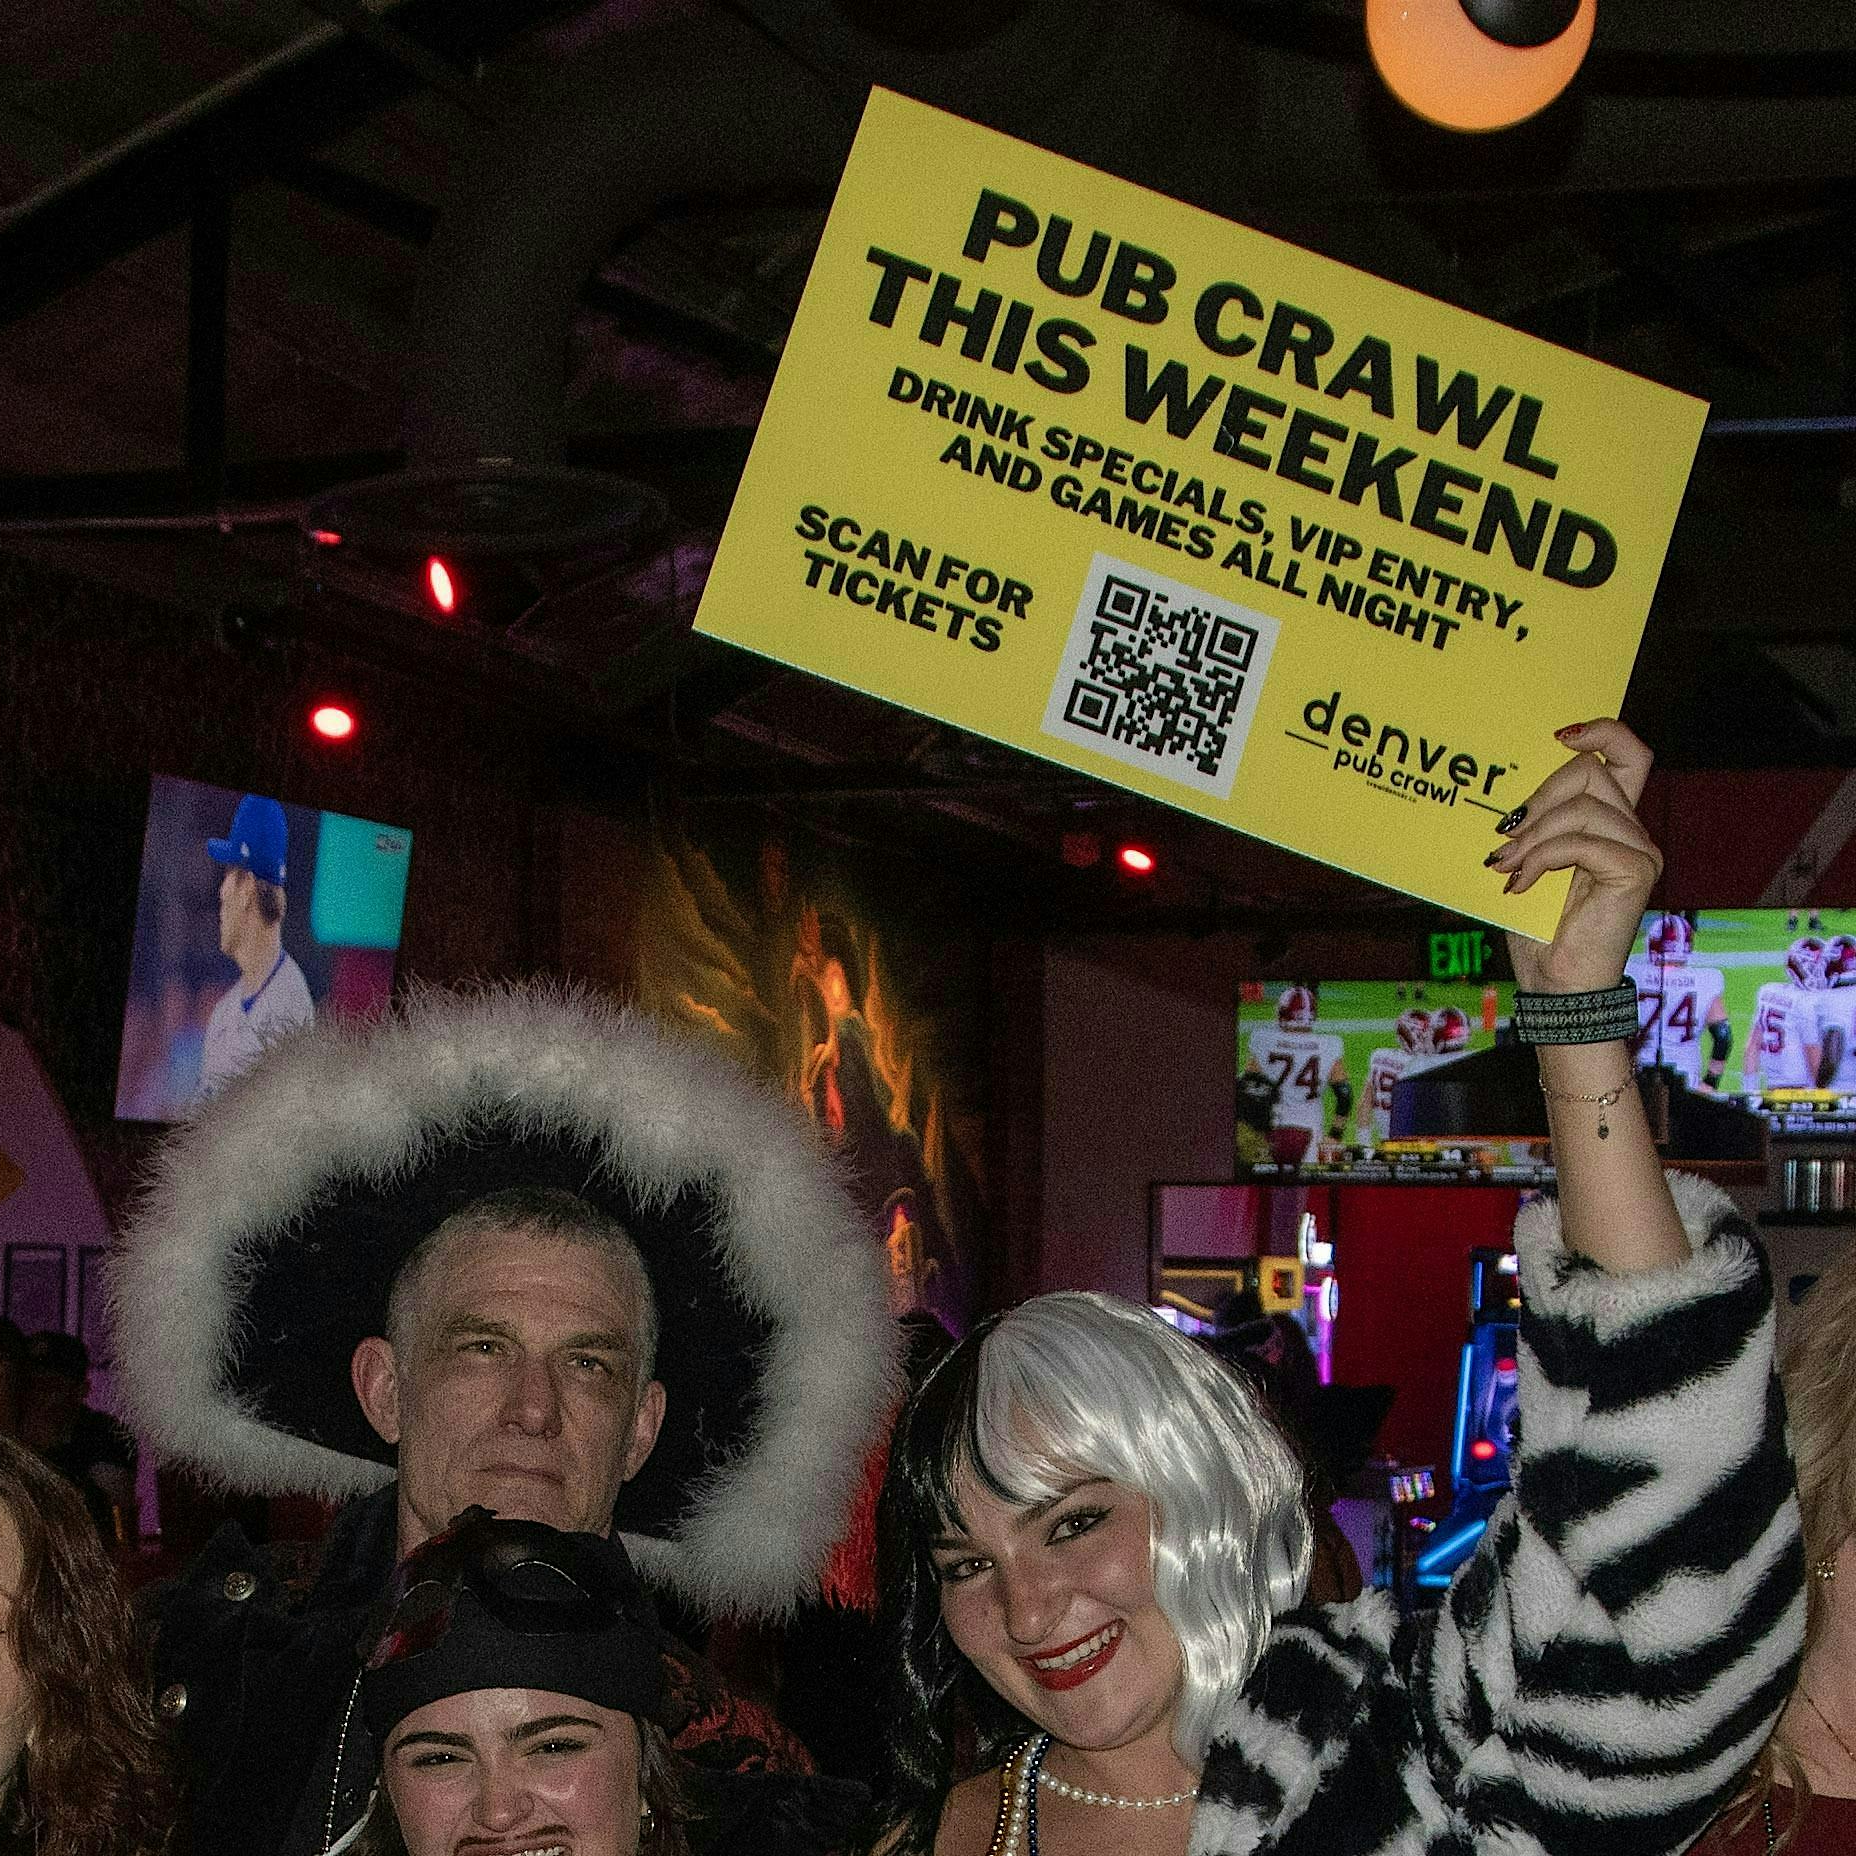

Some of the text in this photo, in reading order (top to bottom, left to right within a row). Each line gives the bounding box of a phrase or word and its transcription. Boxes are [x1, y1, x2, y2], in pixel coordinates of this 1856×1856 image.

[962, 187, 1559, 480] PUB CRAWL
[865, 246, 1618, 590] THIS WEEKEND
[887, 366, 1531, 643] DRINK SPECIALS, VIP ENTRY,
[939, 434, 1460, 653] AND GAMES ALL NIGHT
[795, 505, 1034, 619] SCAN FOR
[803, 551, 1003, 653] TICKETS
[1301, 690, 1507, 797] denver
[1333, 744, 1458, 808] pub crawl
[1429, 933, 1484, 977] EXIT
[1267, 1053, 1321, 1101] 74
